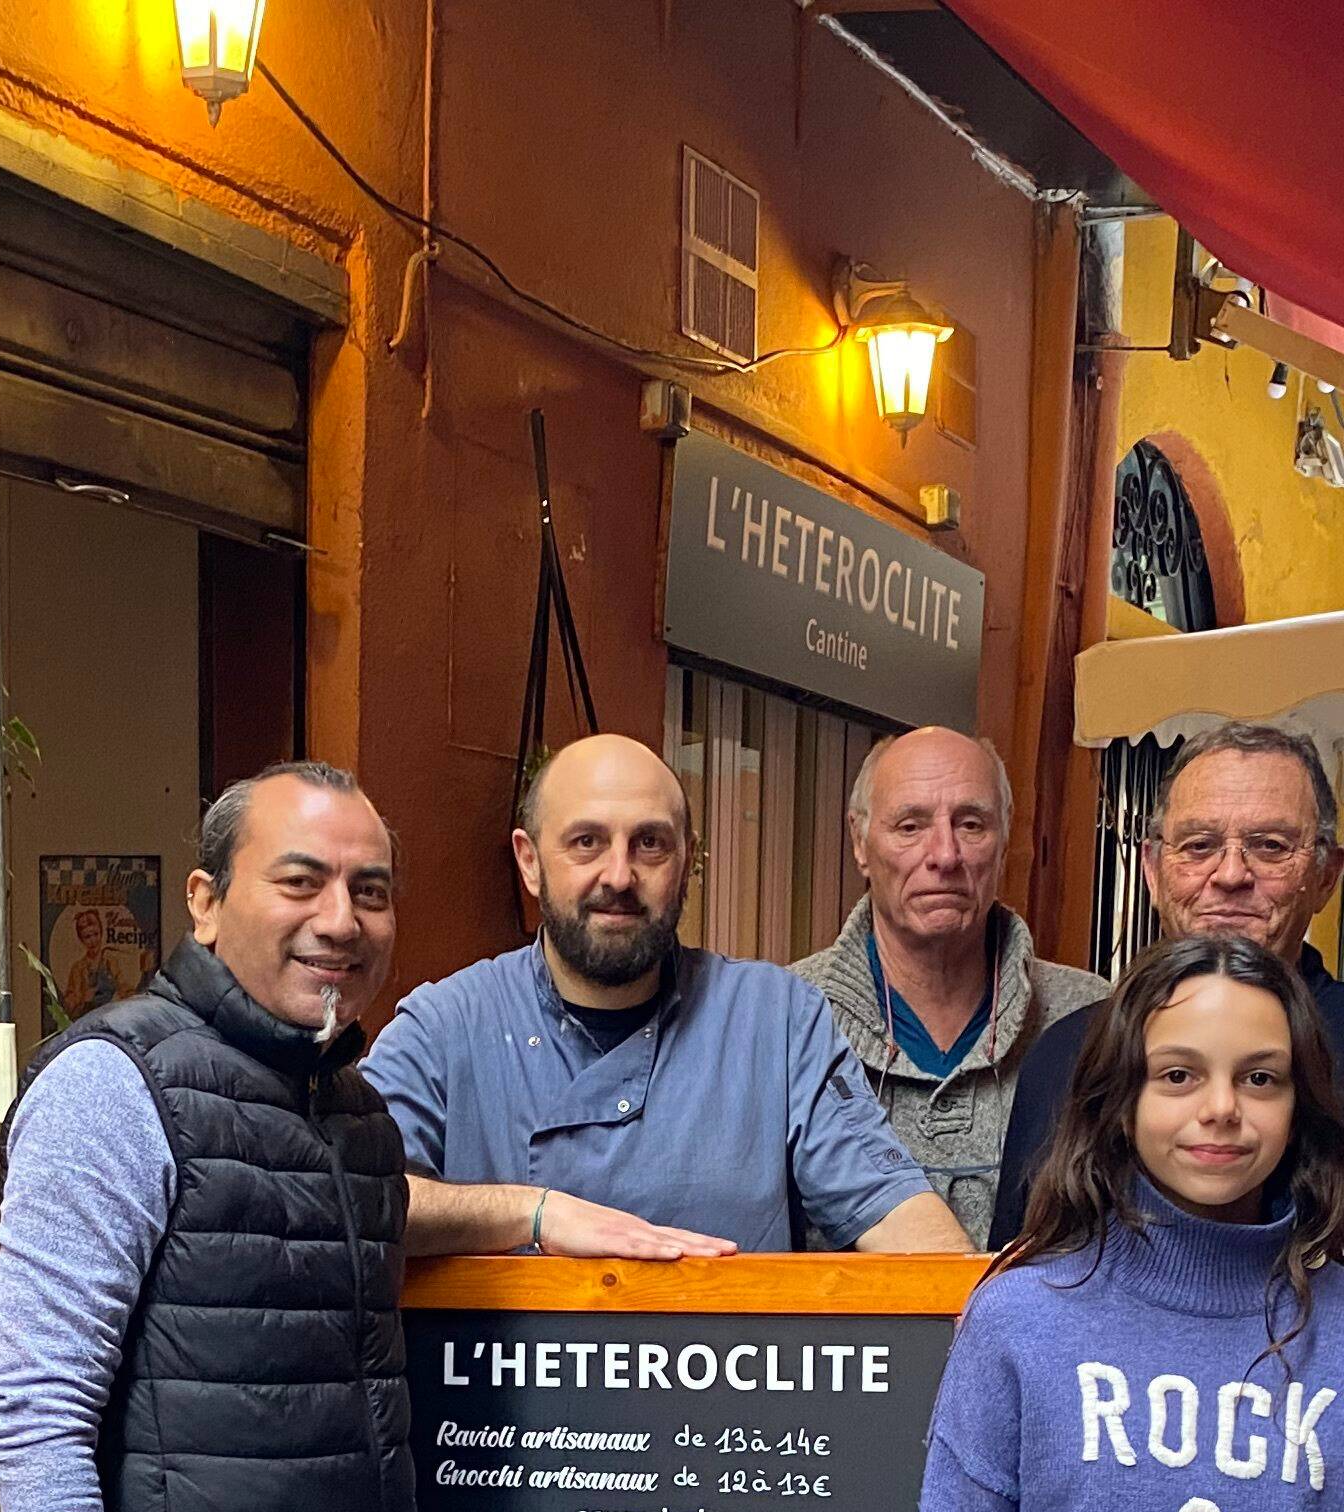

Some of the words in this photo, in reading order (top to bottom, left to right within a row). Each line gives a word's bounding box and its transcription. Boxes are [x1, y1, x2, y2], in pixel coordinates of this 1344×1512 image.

[706, 475, 962, 650] L'HETEROCLITE
[806, 617, 869, 671] Cantine
[444, 1342, 889, 1392] L'HETEROCLITE
[437, 1421, 516, 1448] Ravioli
[521, 1427, 650, 1451] artisanaux
[675, 1424, 706, 1446] de
[1077, 1361, 1338, 1491] ROCK
[437, 1460, 524, 1487] Gnocchi
[529, 1467, 658, 1492] artisanaux
[674, 1466, 699, 1486] de
